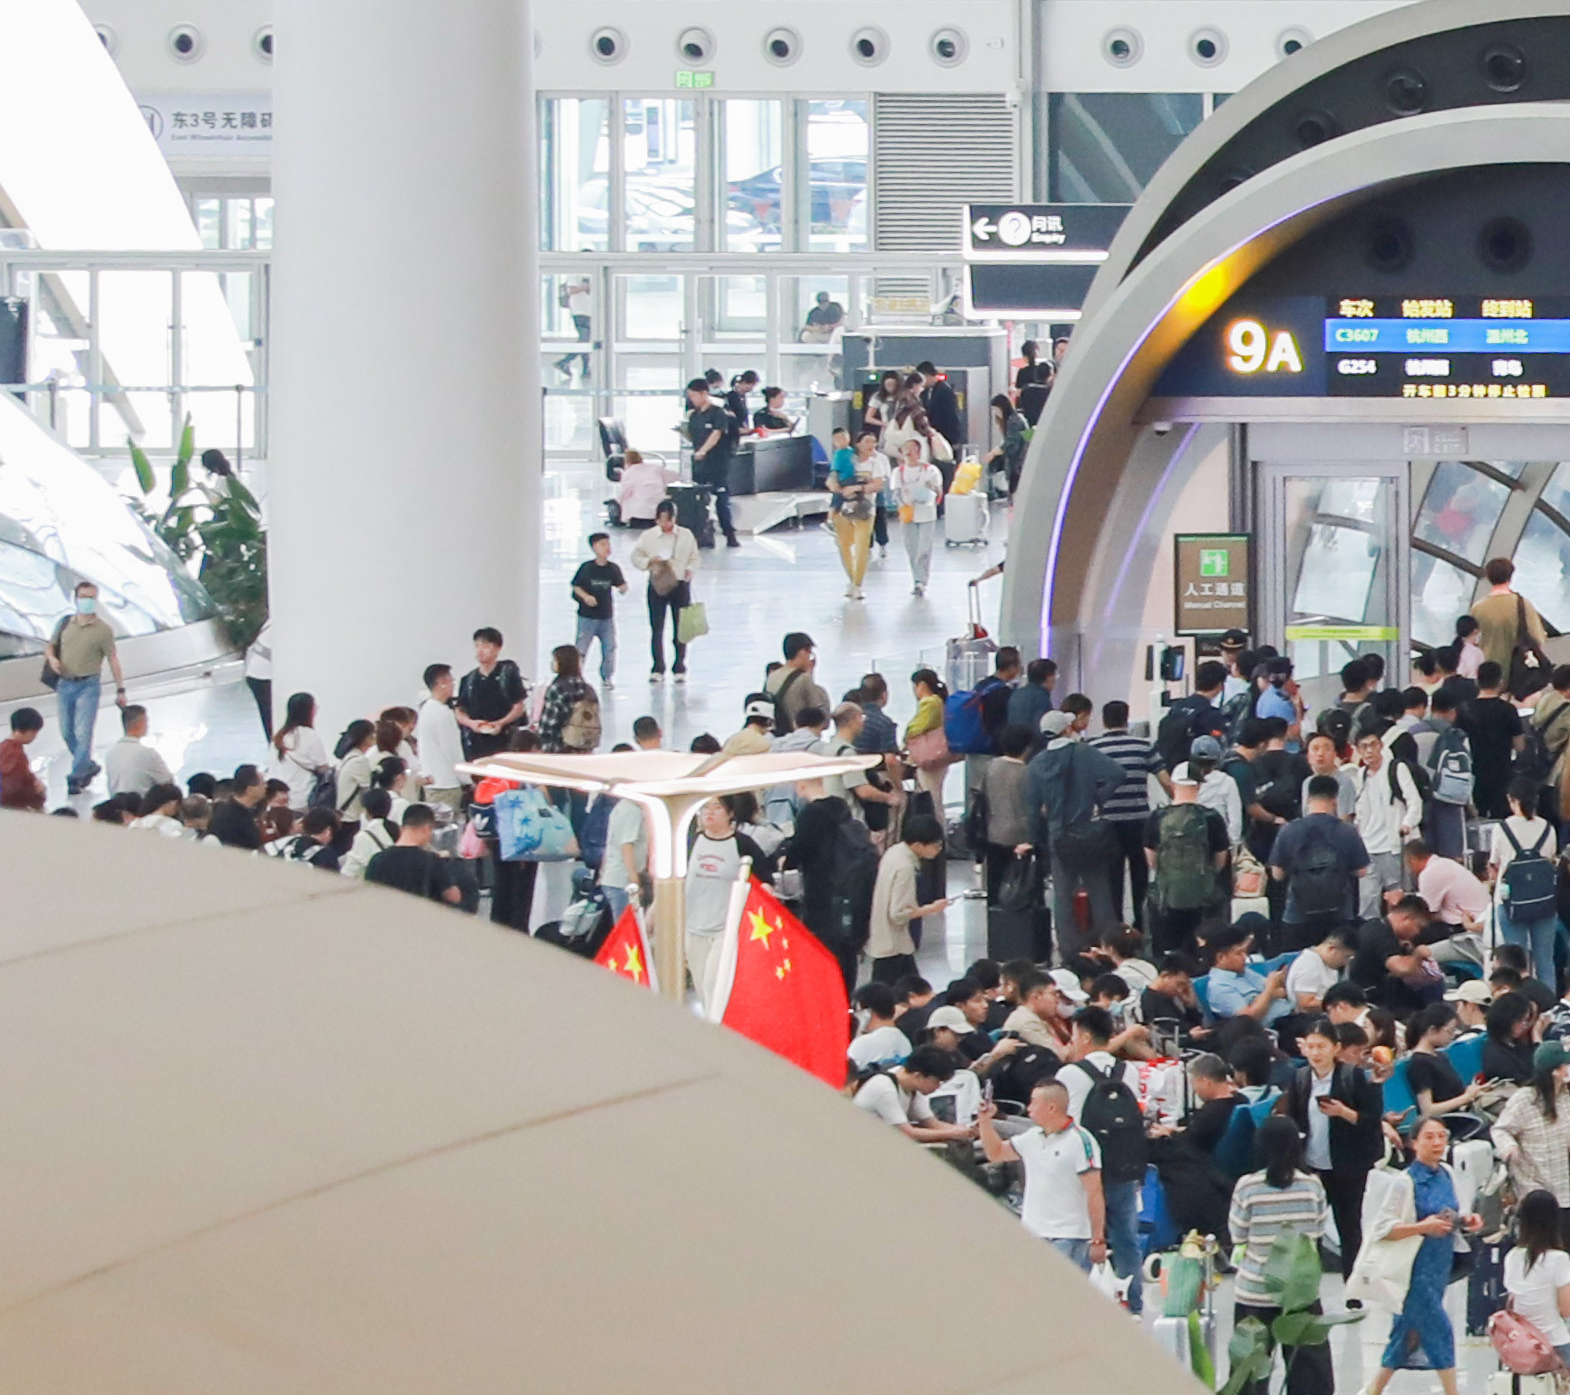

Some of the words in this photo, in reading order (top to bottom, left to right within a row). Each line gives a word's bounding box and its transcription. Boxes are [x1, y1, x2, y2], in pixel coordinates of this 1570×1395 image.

[1032, 216, 1063, 232] 问讯
[1340, 300, 1373, 317] 车次
[1225, 319, 1301, 372] 9A
